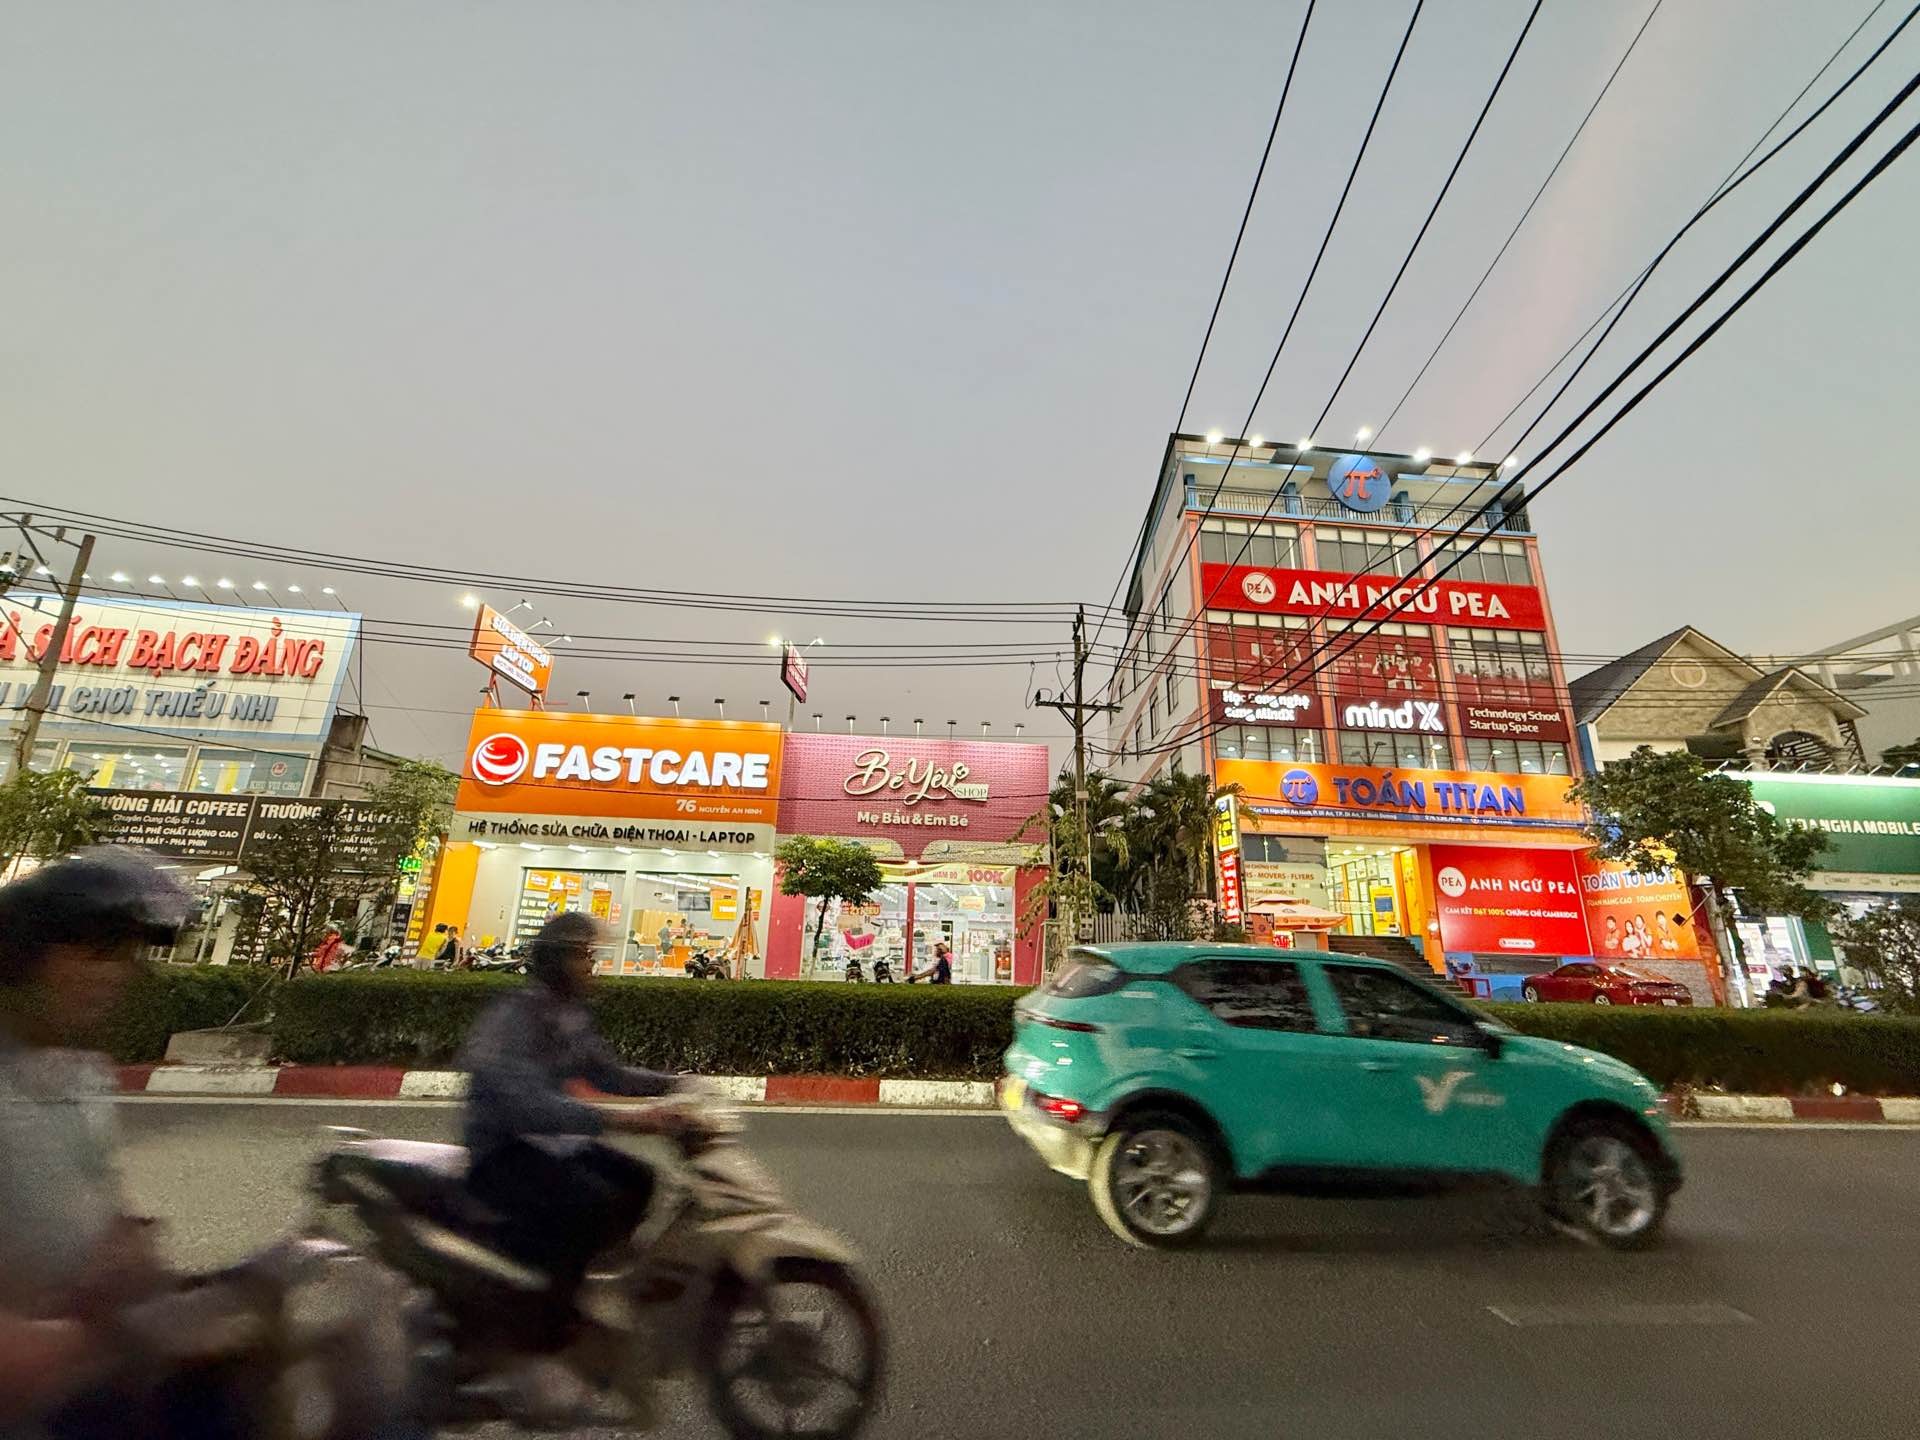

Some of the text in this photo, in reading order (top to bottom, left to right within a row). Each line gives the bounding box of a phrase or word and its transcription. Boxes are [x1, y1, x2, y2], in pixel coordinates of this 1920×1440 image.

[1246, 583, 1272, 595] PEA
[1288, 580, 1511, 619] ANH NGỮ PEA
[127, 629, 230, 678] BẠCH
[228, 617, 325, 679] ĐẰNG
[69, 685, 138, 715] CHƠI
[145, 680, 227, 719] THIẾU
[230, 695, 279, 722] NHI
[1467, 707, 1561, 722] Technology School
[1469, 719, 1540, 734] Startup Space
[532, 743, 770, 789] FASTCARE
[844, 748, 958, 806] Bé Yêu
[955, 787, 988, 798] SHOP
[1333, 771, 1526, 814] TOÁN TITAN
[152, 795, 181, 814] HẢI
[185, 800, 249, 817] COFFEE
[676, 799, 697, 812] 76
[857, 809, 969, 827] Mẹ Bầu & Em Bé
[129, 824, 144, 834] CÀ
[145, 824, 161, 835] PHÊ
[162, 824, 187, 836] CHẤT
[187, 828, 216, 838] LƯỢNG
[218, 830, 239, 839] CAO
[468, 819, 487, 836] HỆ
[490, 818, 539, 836] THỐNG
[541, 820, 568, 837] SỬA
[571, 822, 610, 839] CHỮA
[612, 824, 645, 842] ĐIỆN
[648, 828, 690, 843] THOẠI
[700, 830, 755, 844] LAPTOP
[169, 838, 187, 846] PHA
[188, 838, 207, 847] PHIN
[966, 869, 1005, 885] 100K
[1257, 872, 1287, 880] MOVERS
[1290, 873, 1314, 881] FLYERS
[1441, 877, 1463, 887] PEA
[1582, 869, 1620, 891] TOÁN
[1470, 878, 1577, 895] ANH NGỮ PEA
[1619, 896, 1633, 904] CAO
[1445, 906, 1460, 914] CAM
[1460, 905, 1473, 915] KẾT
[1487, 908, 1505, 916] 100%
[1505, 907, 1530, 917] CHỨNG
[1542, 910, 1578, 919] CAMBRIDGE
